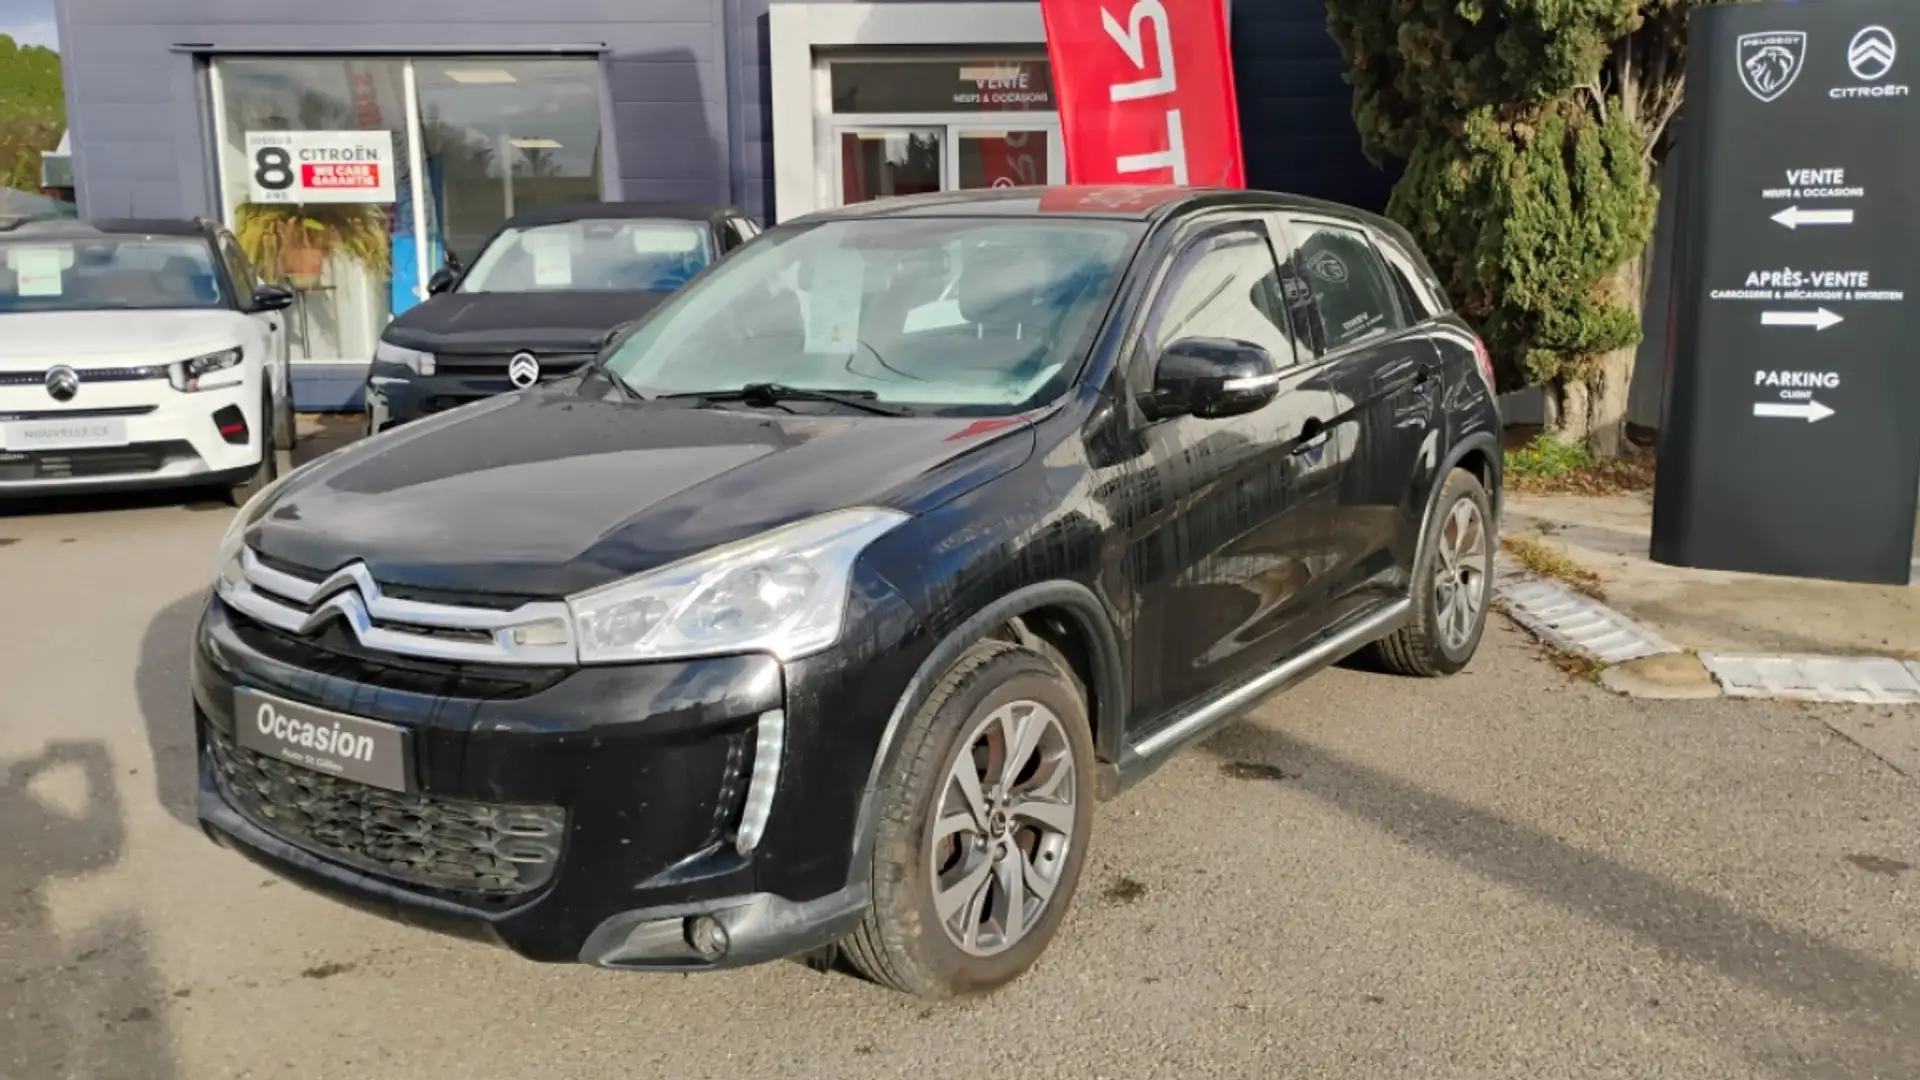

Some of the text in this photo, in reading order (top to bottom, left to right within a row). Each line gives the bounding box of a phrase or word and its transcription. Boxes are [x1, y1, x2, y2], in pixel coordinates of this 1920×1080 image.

[976, 73, 1029, 89] VENTE
[992, 92, 1048, 103] OCCASIONS
[299, 144, 378, 161] CITROËN
[254, 146, 294, 190] 8
[1786, 168, 1845, 186] VENTE
[1803, 187, 1864, 198] OCCASIONS
[1745, 266, 1869, 288] APRÈS-VENTE
[1754, 370, 1841, 388] PARKING
[1779, 389, 1813, 399] CLIENT
[257, 702, 375, 762] Occasion
